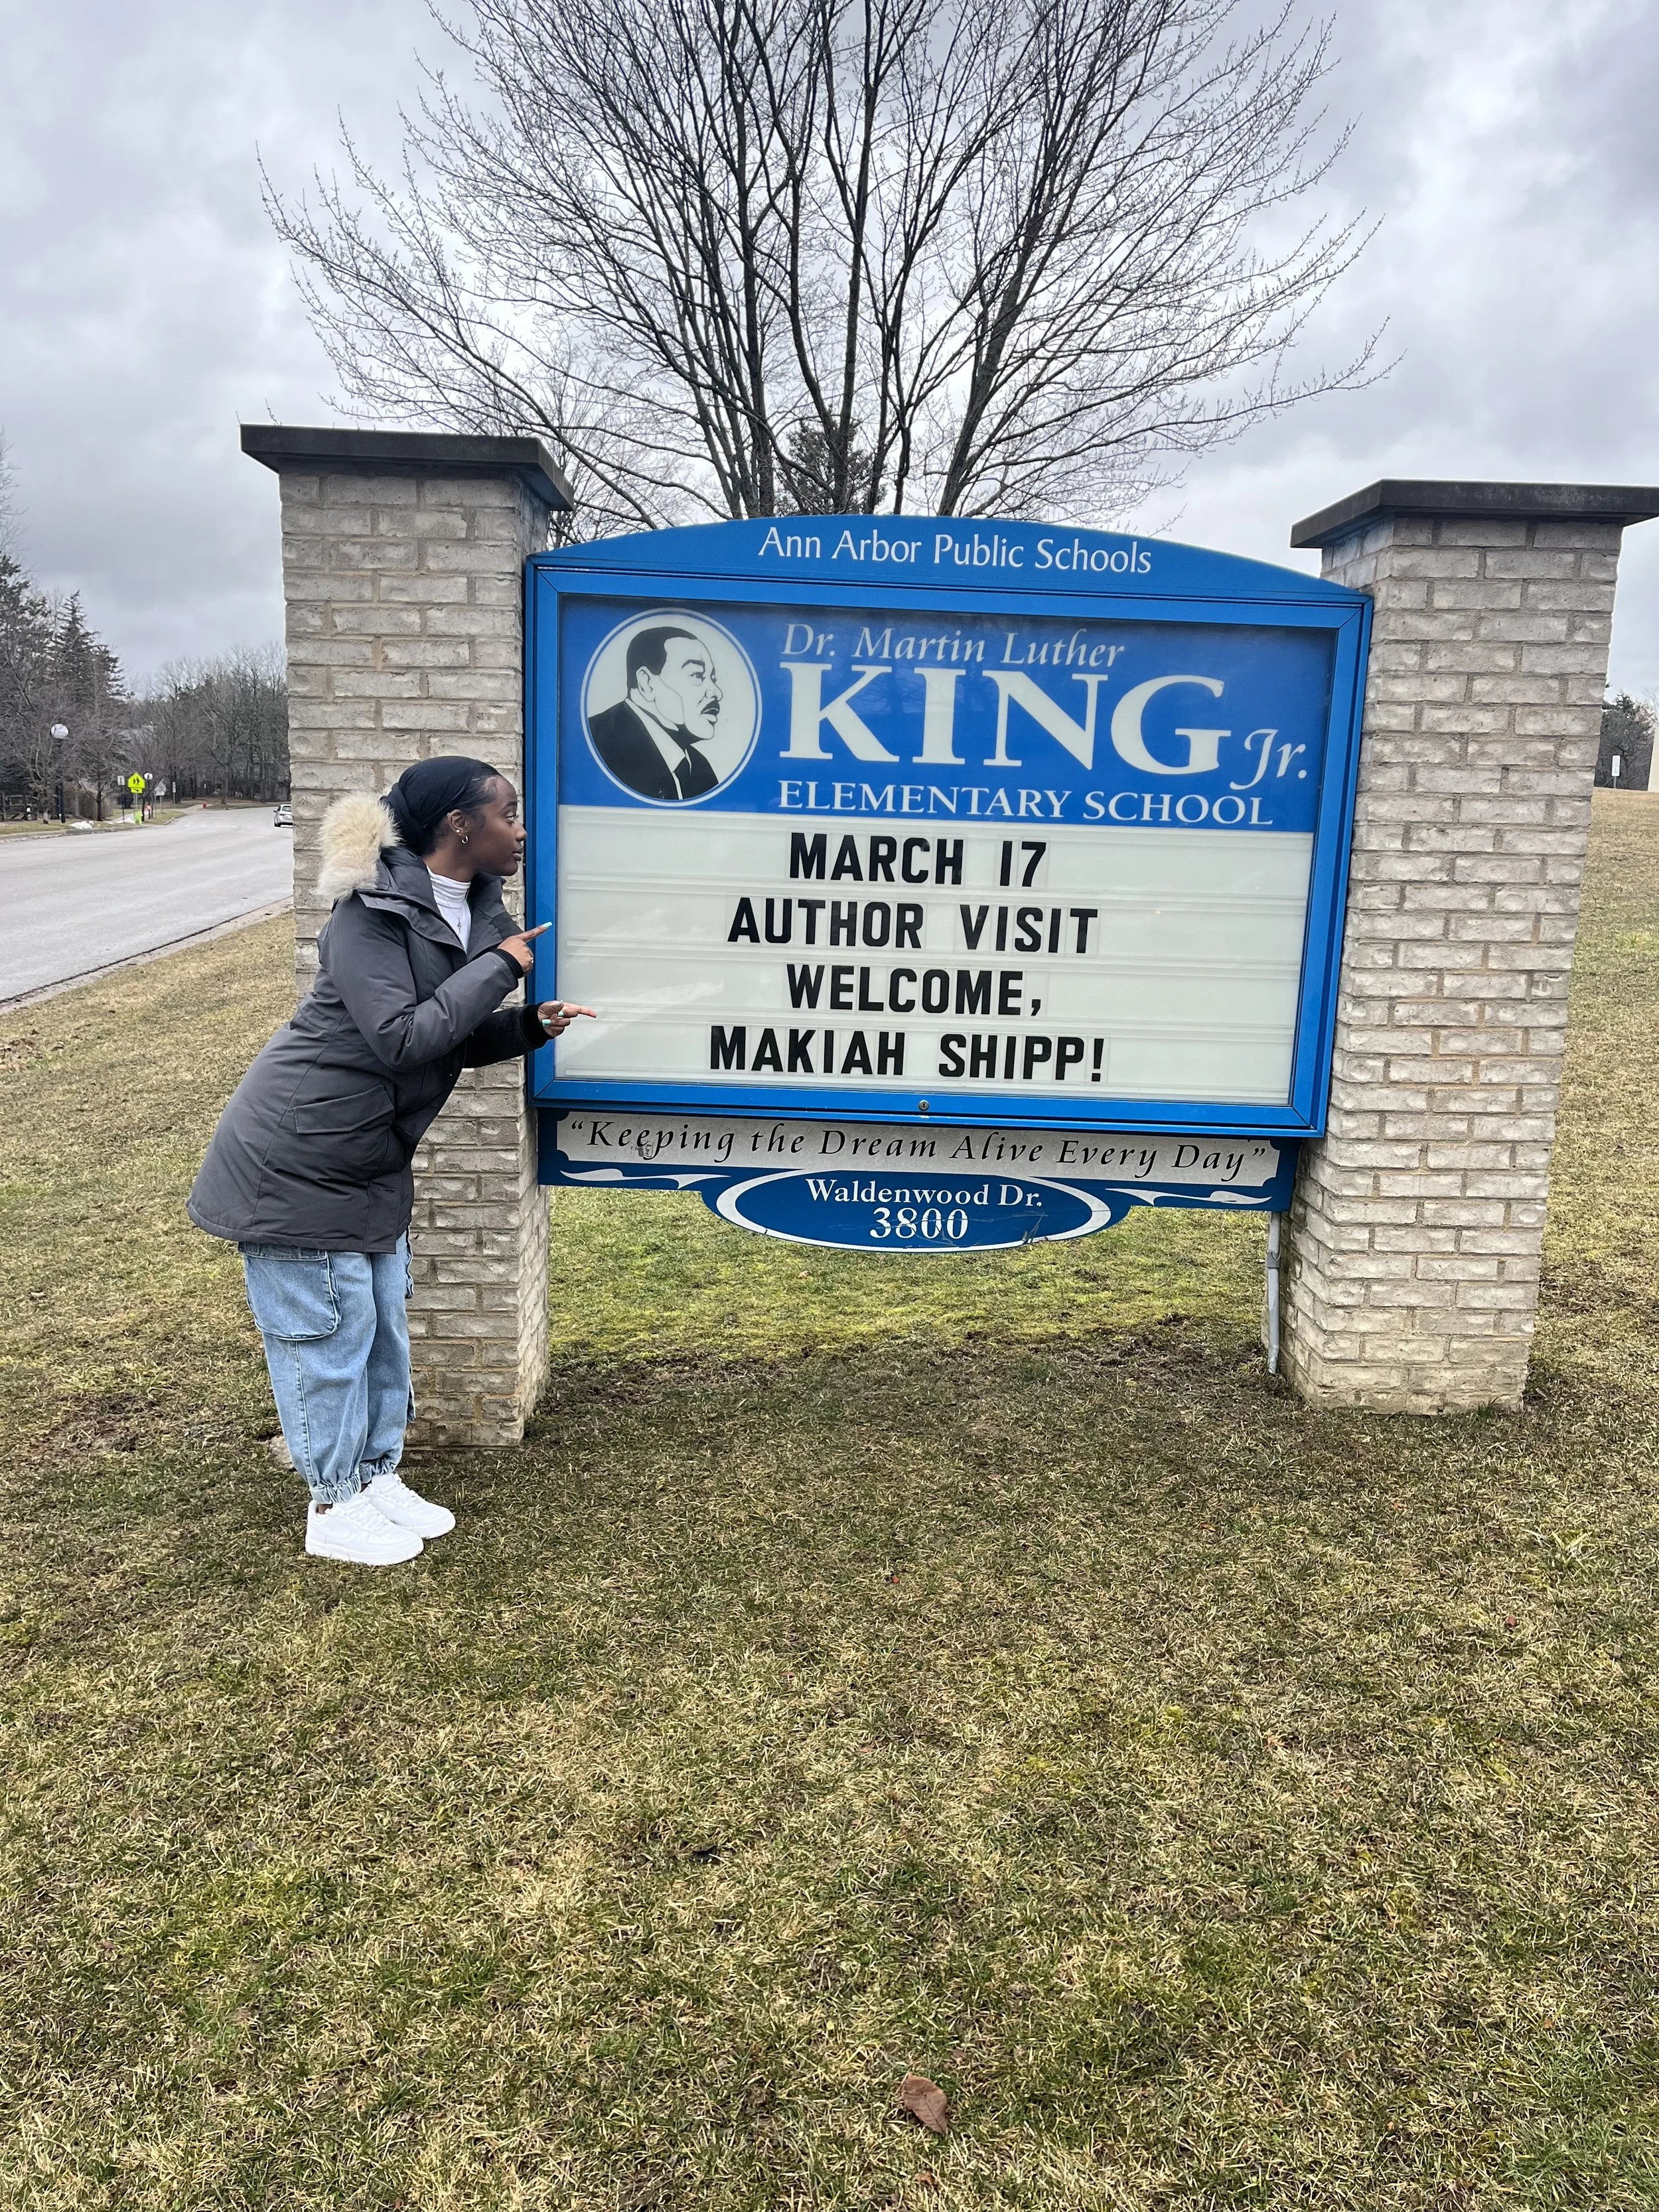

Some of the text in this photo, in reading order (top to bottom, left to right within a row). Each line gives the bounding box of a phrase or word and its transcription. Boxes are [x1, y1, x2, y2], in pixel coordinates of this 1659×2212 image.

[758, 526, 1152, 573] Ann Arbor Public Schools
[781, 623, 1125, 667] Dr. Martin Luther
[779, 662, 1307, 790] KING Jr.
[778, 780, 1273, 826] ELEMENTARY SCHOOL
[789, 832, 1046, 887] MARCH 17
[727, 897, 1098, 954] AUTHOR VISIT
[786, 964, 1042, 1017] WELCOME,
[710, 1025, 1104, 1082] MAKIAH SHIPP!
[751, 1123, 804, 1154] the
[818, 1129, 936, 1159] Dream
[948, 1131, 1043, 1163] Alive
[1055, 1139, 1158, 1179] Every
[805, 1178, 1043, 1207] Waldenwood Dr.
[869, 1207, 968, 1240] 3800
